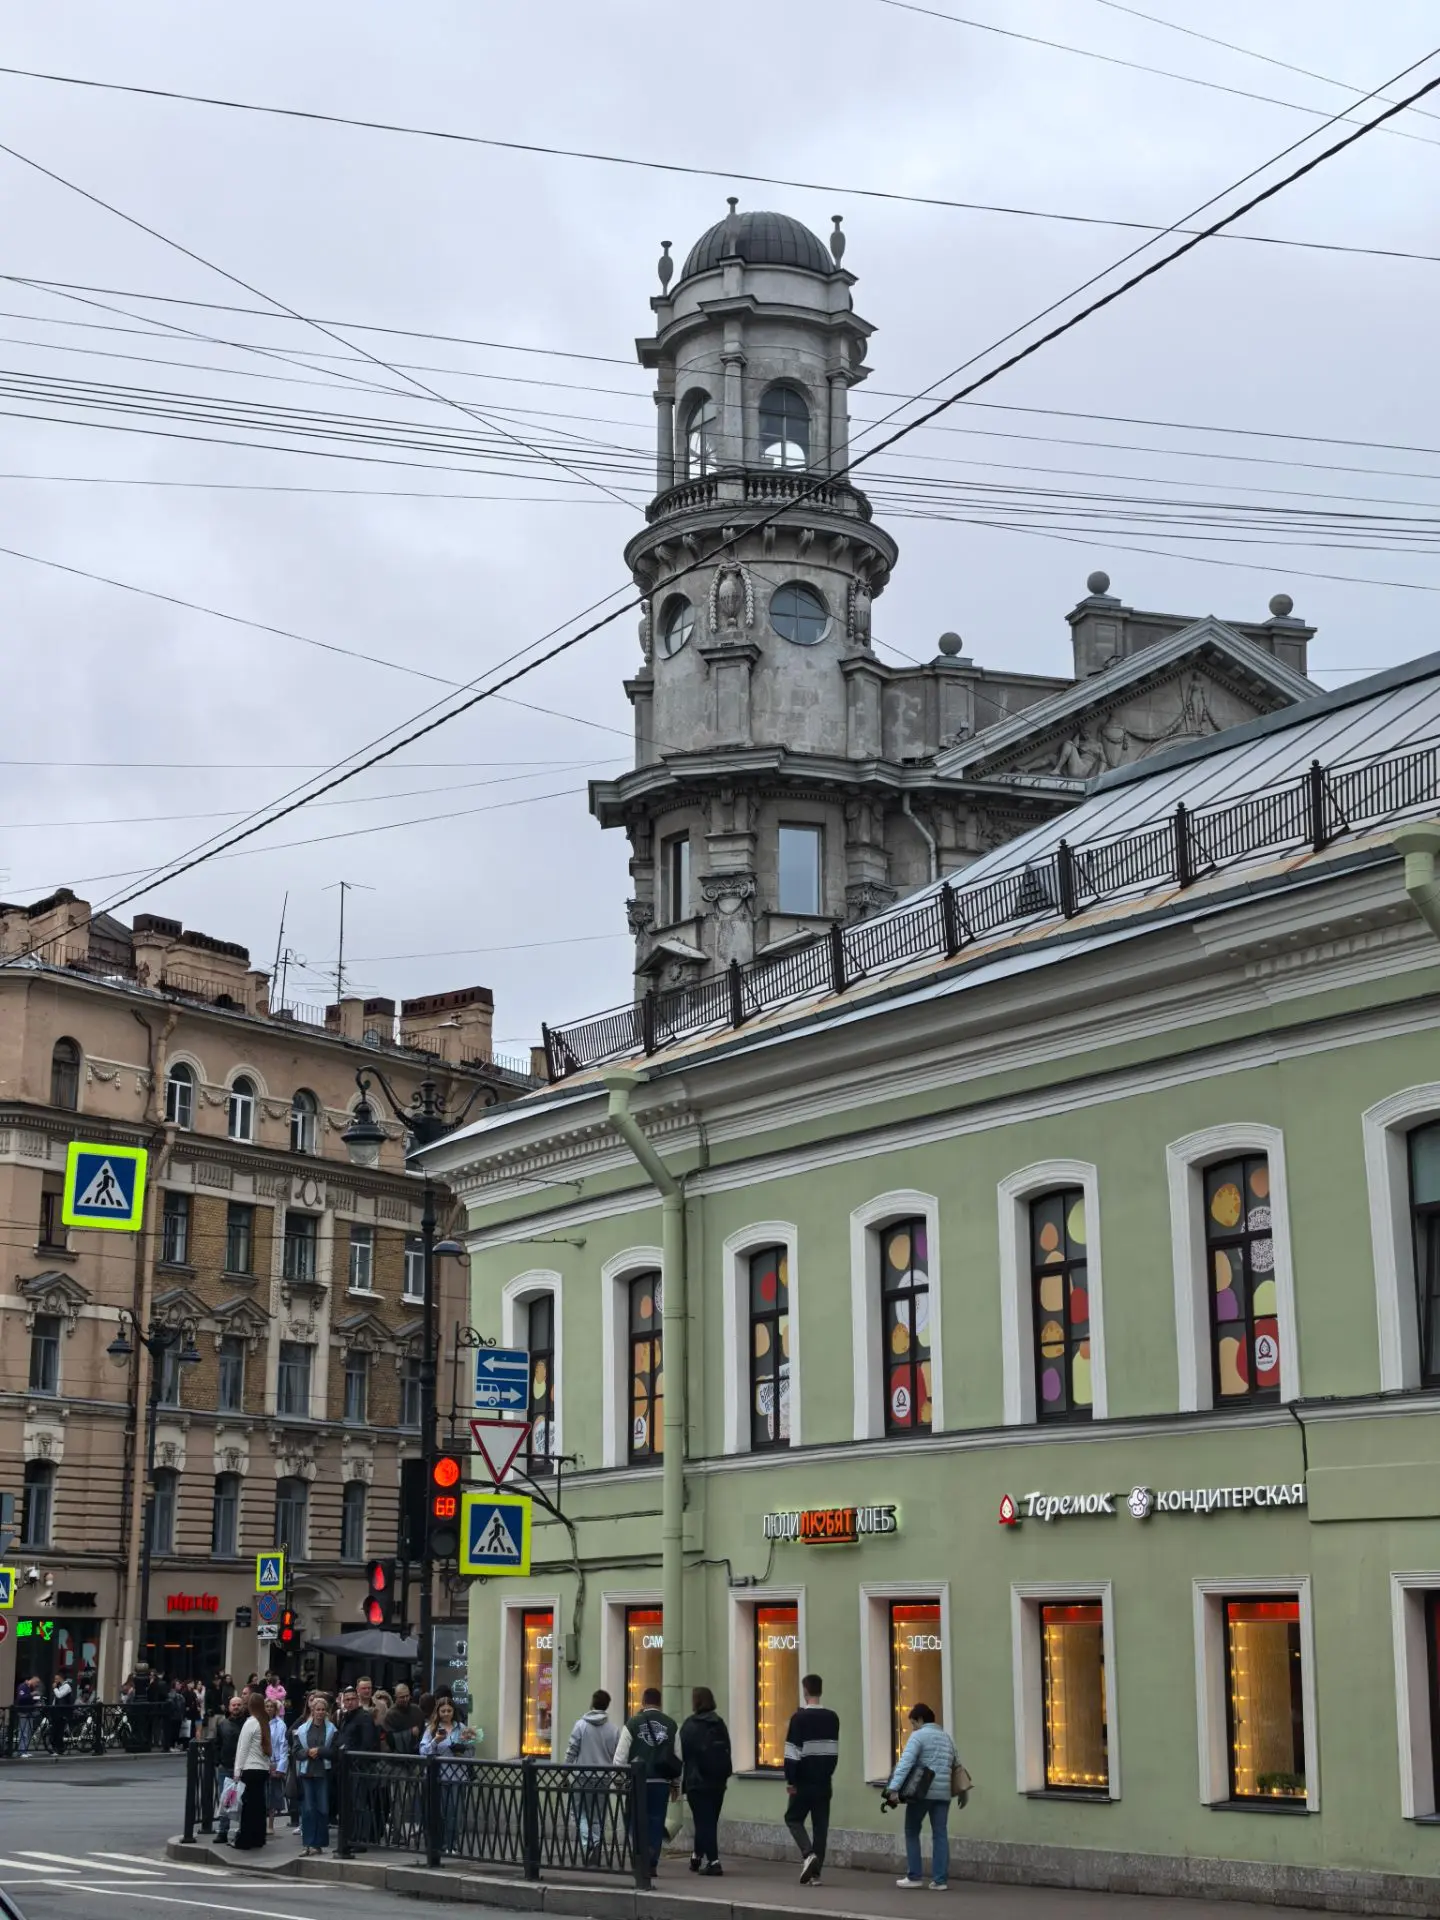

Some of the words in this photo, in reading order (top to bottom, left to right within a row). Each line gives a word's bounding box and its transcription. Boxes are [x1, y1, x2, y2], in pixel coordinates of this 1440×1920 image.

[436, 1497, 455, 1516] 68
[1024, 1491, 1114, 1521] Теремок
[1157, 1483, 1304, 1513] КОНДИТЕРСКАЯ
[763, 1512, 800, 1539] ЛЮДИ
[800, 1508, 853, 1536] ЛЮБЯТ
[856, 1506, 893, 1533] ХЛЕБ
[642, 1635, 664, 1649] САМ
[907, 1635, 942, 1652] ЗДЕСЬ
